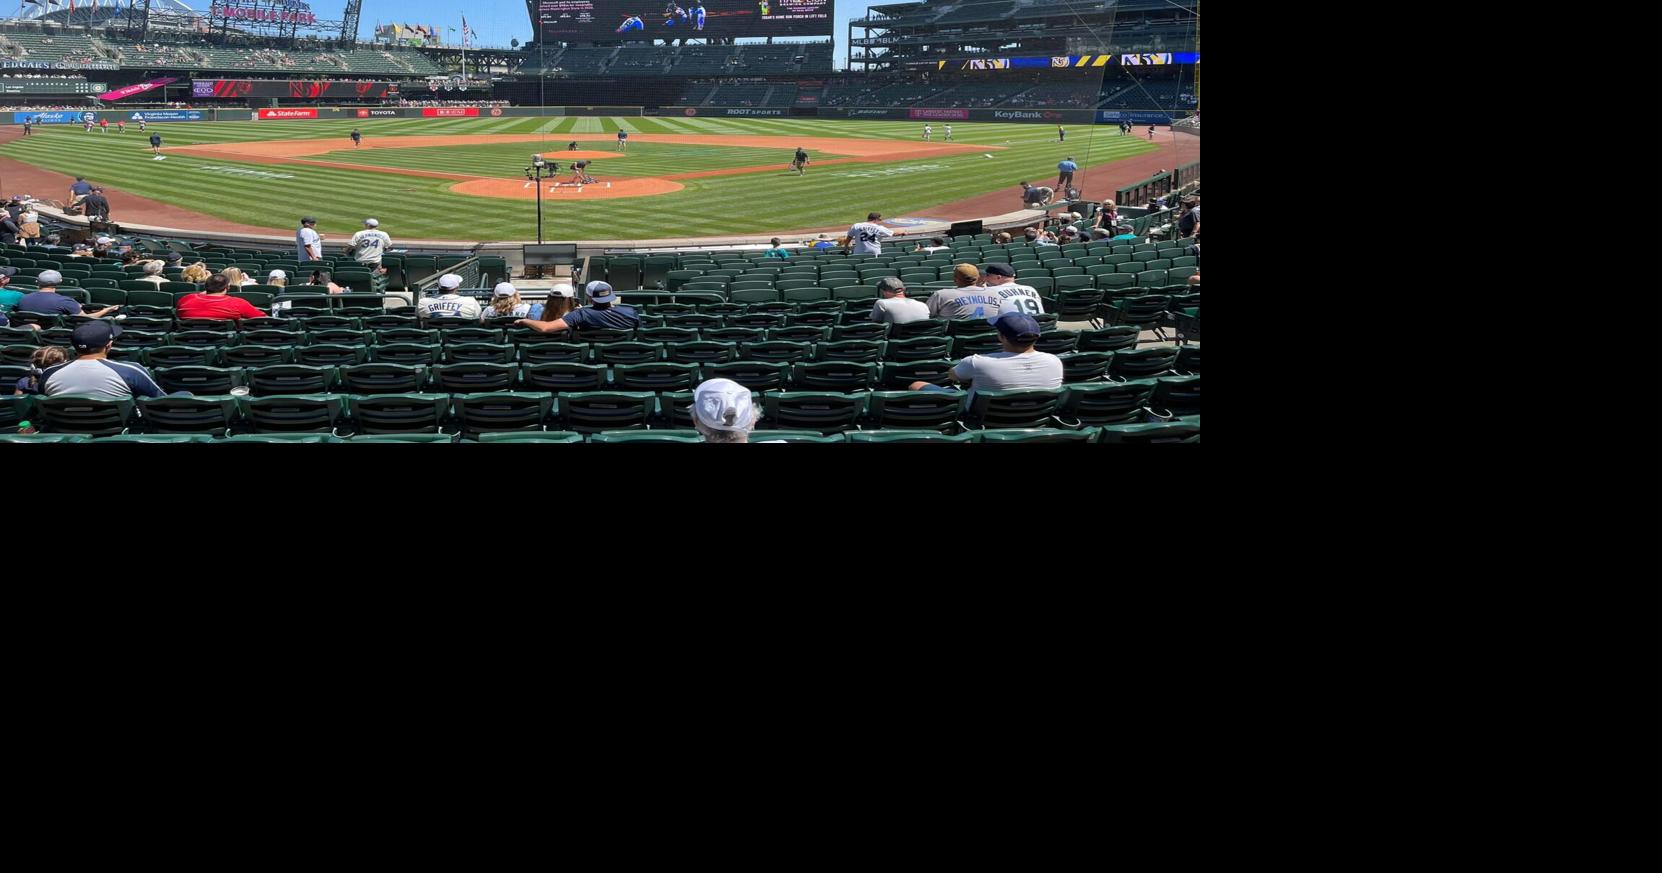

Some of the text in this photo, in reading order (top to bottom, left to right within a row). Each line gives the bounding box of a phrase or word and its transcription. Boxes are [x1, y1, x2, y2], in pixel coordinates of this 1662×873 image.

[727, 107, 751, 115] ROOT
[994, 110, 1042, 119] KeyBank
[860, 232, 877, 243] 24
[361, 239, 379, 249] 34
[998, 287, 1038, 299] BUHNER
[956, 295, 1000, 307] REYNOLDS
[428, 302, 463, 312] GRIFFEY
[1014, 298, 1040, 315] 19
